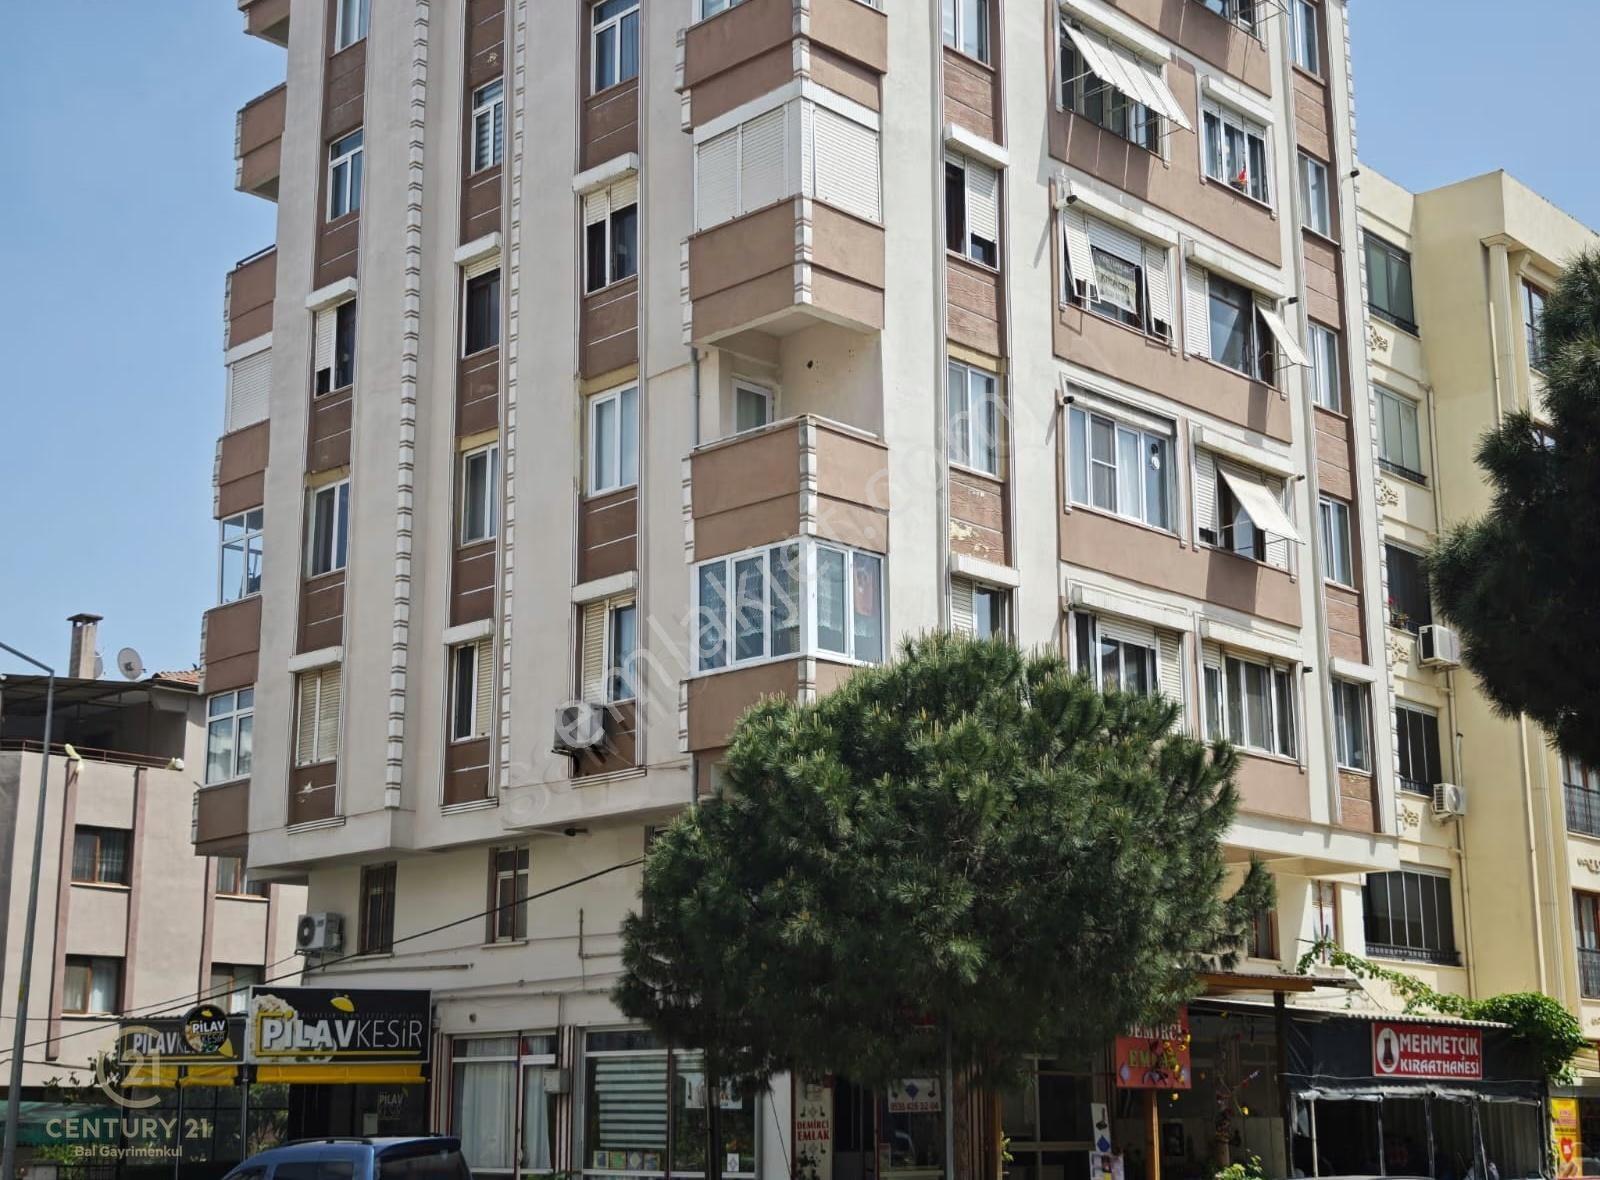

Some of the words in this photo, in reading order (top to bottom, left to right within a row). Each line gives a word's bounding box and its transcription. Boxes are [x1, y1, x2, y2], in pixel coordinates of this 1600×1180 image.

[1400, 1032, 1479, 1060] MEHMETÇİK
[1400, 1058, 1480, 1075] KIRAATHANESİ
[797, 1130, 830, 1141] EMLAK
